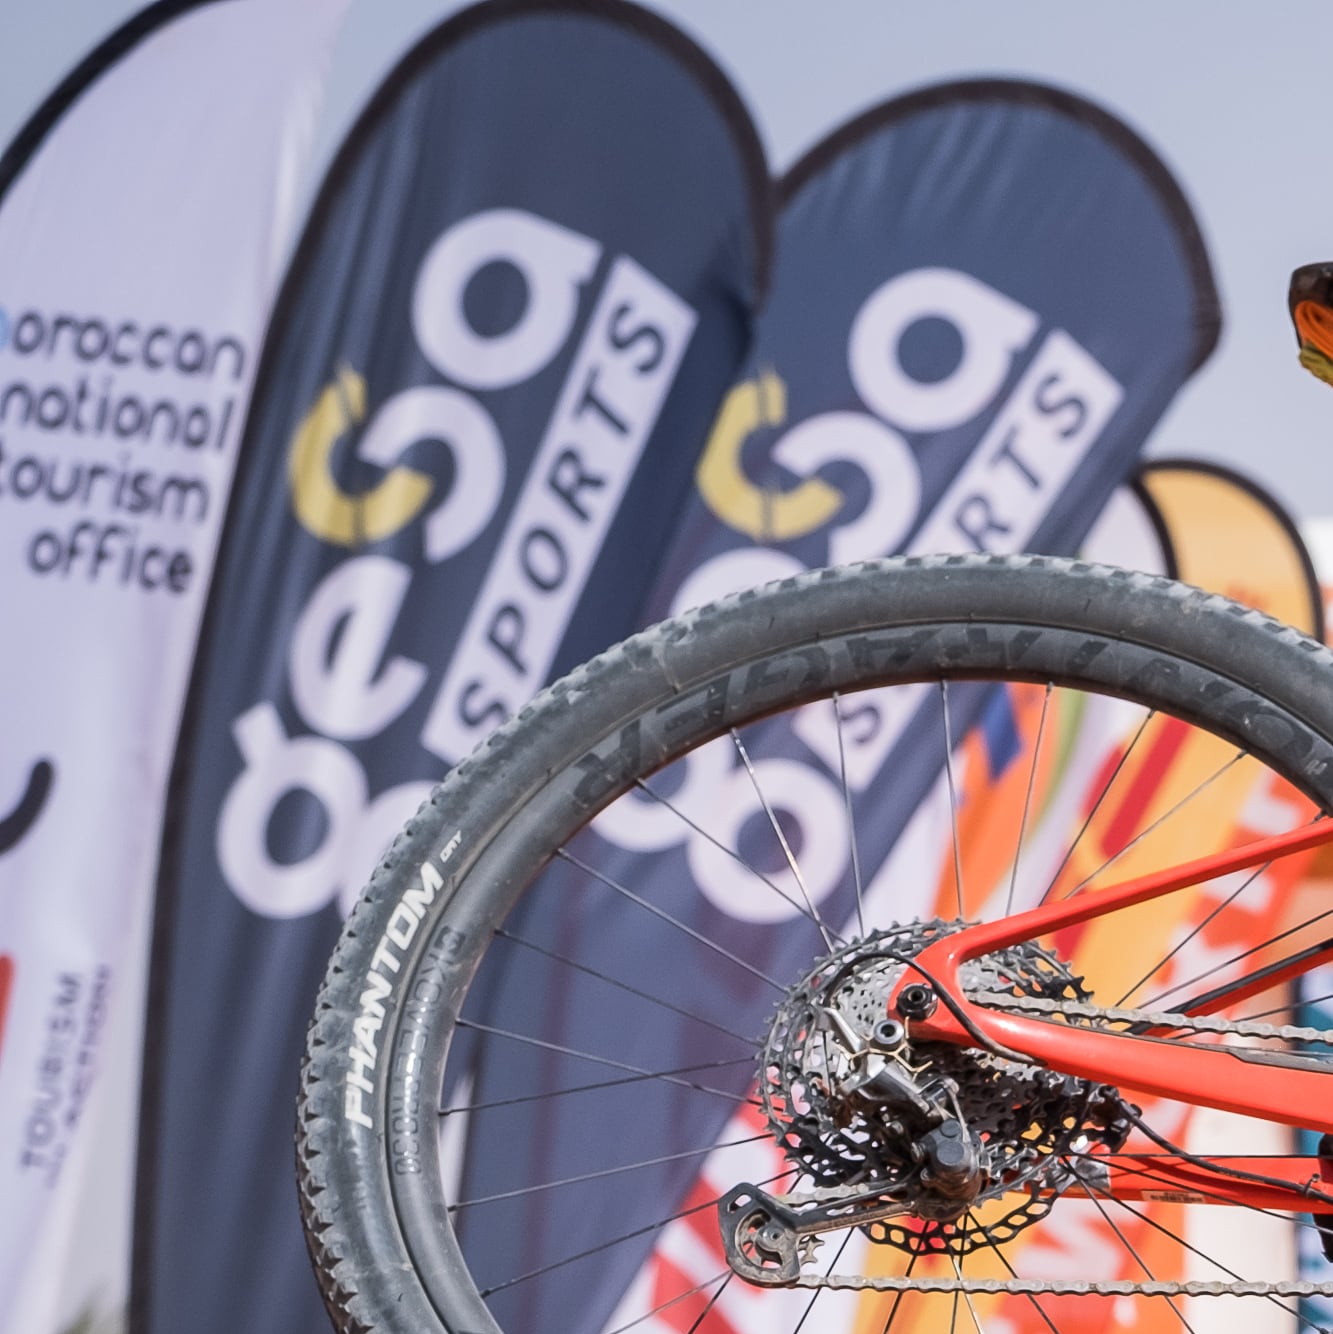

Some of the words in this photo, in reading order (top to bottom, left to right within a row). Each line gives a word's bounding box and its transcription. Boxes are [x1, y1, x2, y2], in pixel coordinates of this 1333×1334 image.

[0, 307, 244, 383] oroccan
[0, 374, 235, 450] national
[0, 440, 212, 524] ourism
[457, 300, 668, 738] SPORTS
[26, 518, 193, 595] office
[848, 378, 1092, 748] SRTS
[345, 858, 445, 1129] PHANTOM
[440, 830, 464, 863] DRY
